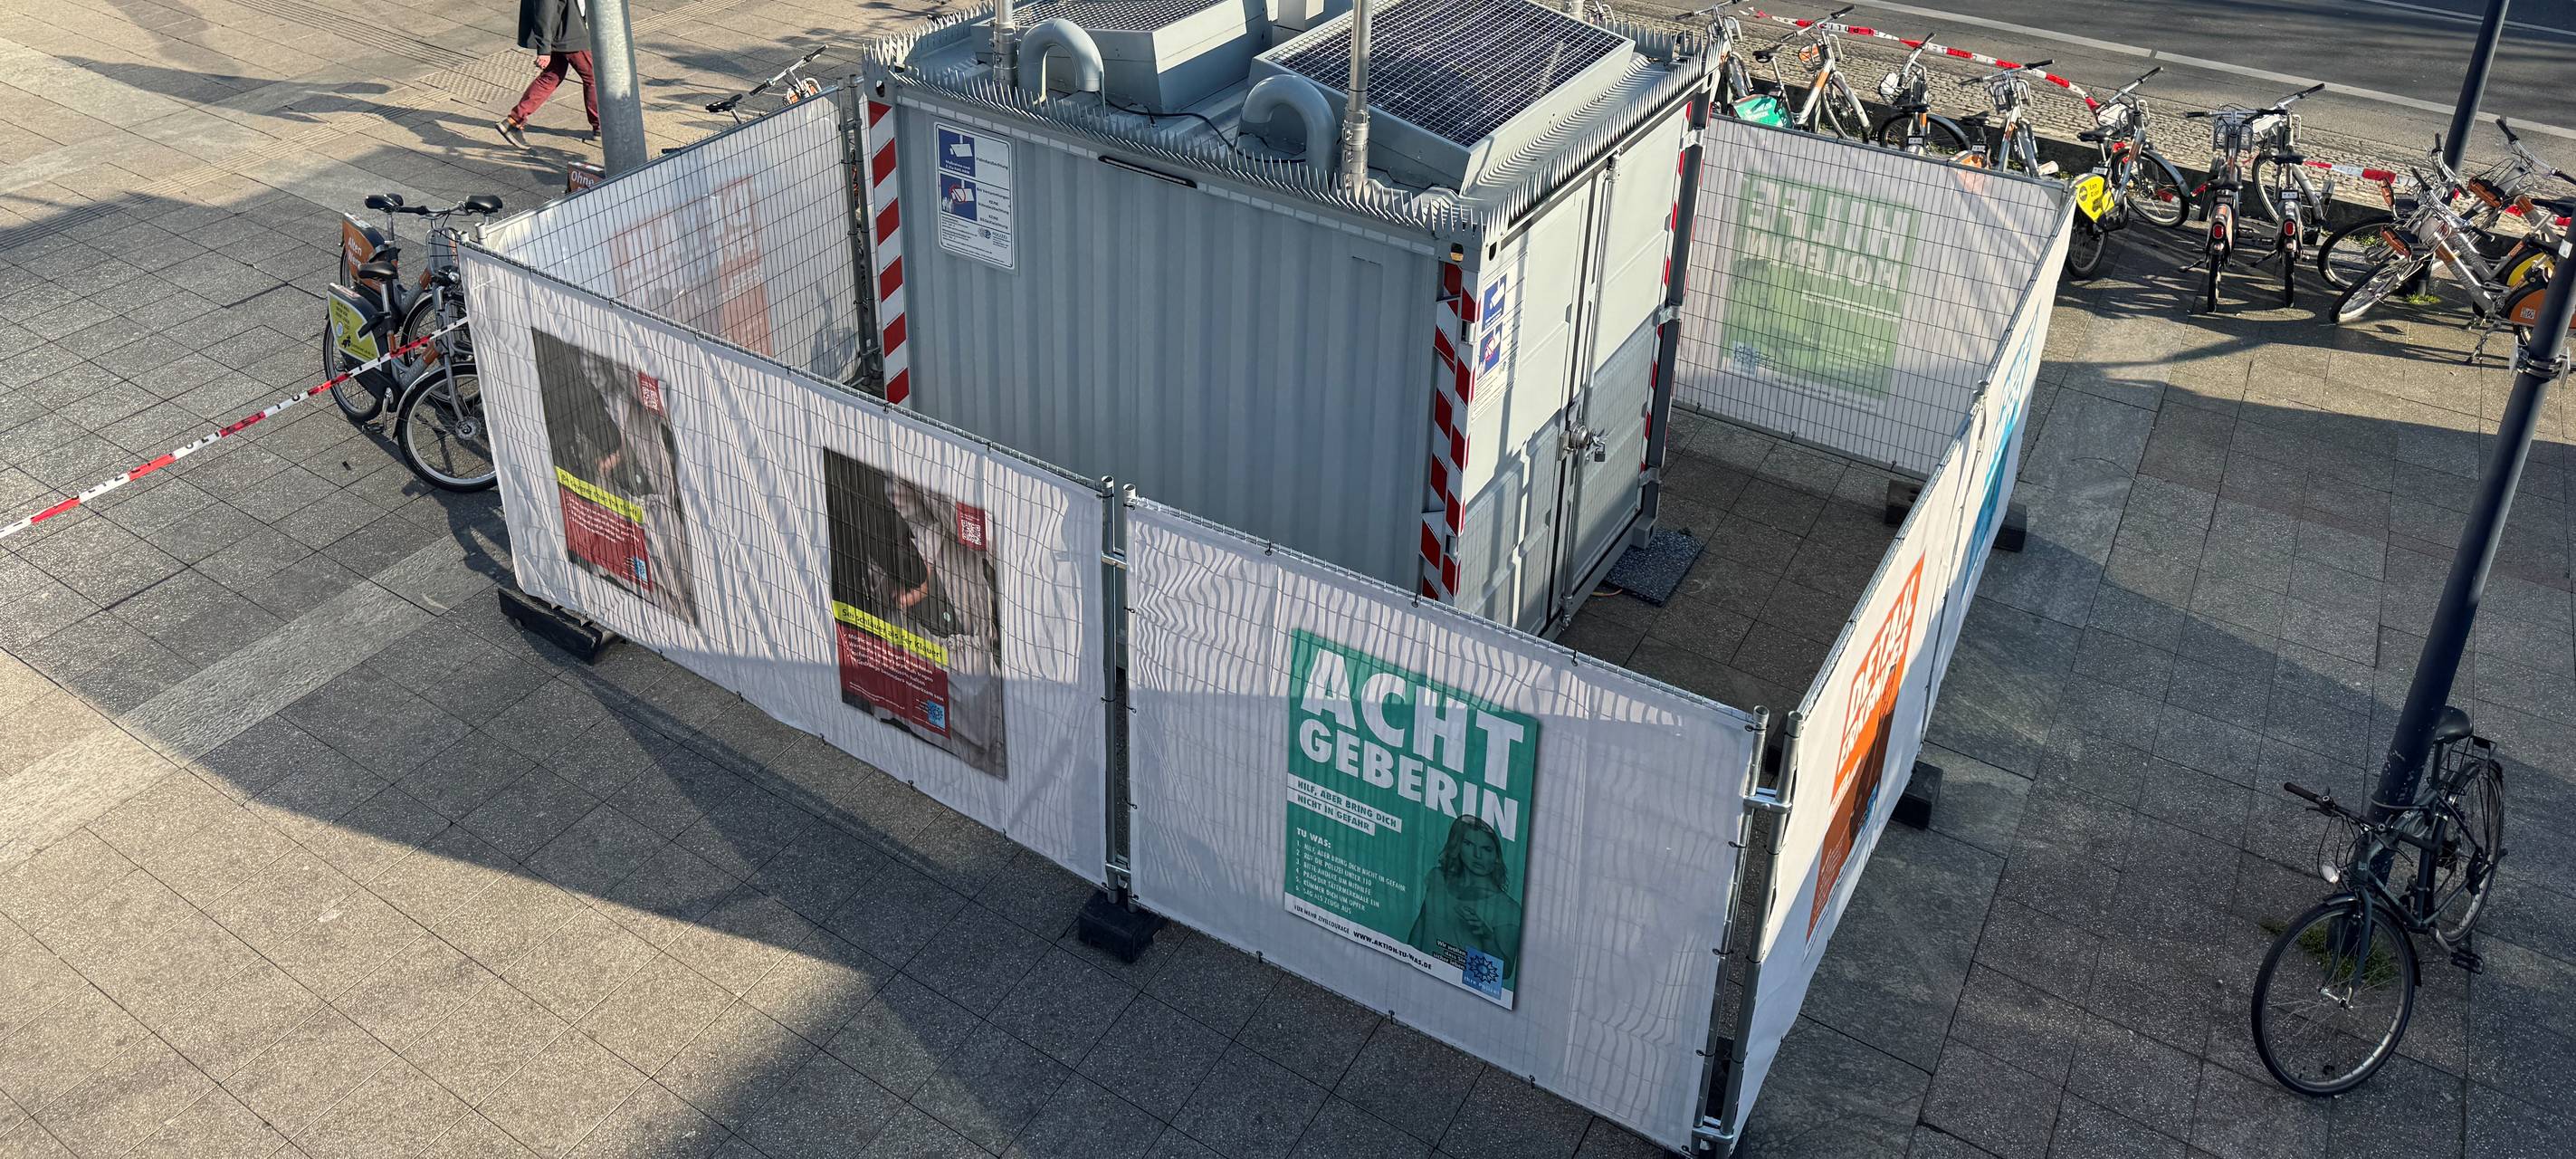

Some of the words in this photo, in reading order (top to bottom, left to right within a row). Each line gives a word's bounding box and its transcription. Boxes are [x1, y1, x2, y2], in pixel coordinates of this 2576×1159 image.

[1845, 572, 1918, 726] DETAIL
[1301, 647, 1524, 790] ACHT
[1297, 780, 1317, 797] HILF,
[1320, 790, 1342, 806] ABER
[1345, 799, 1373, 818] BRING
[1376, 812, 1397, 828] DICH
[1297, 795, 1322, 810] NICHT
[1324, 805, 1334, 816] IN
[1337, 810, 1369, 830] GEFAHR
[1299, 719, 1519, 842] GEBERIN
[1296, 827, 1307, 838] TU
[1309, 833, 1331, 848] WAS:
